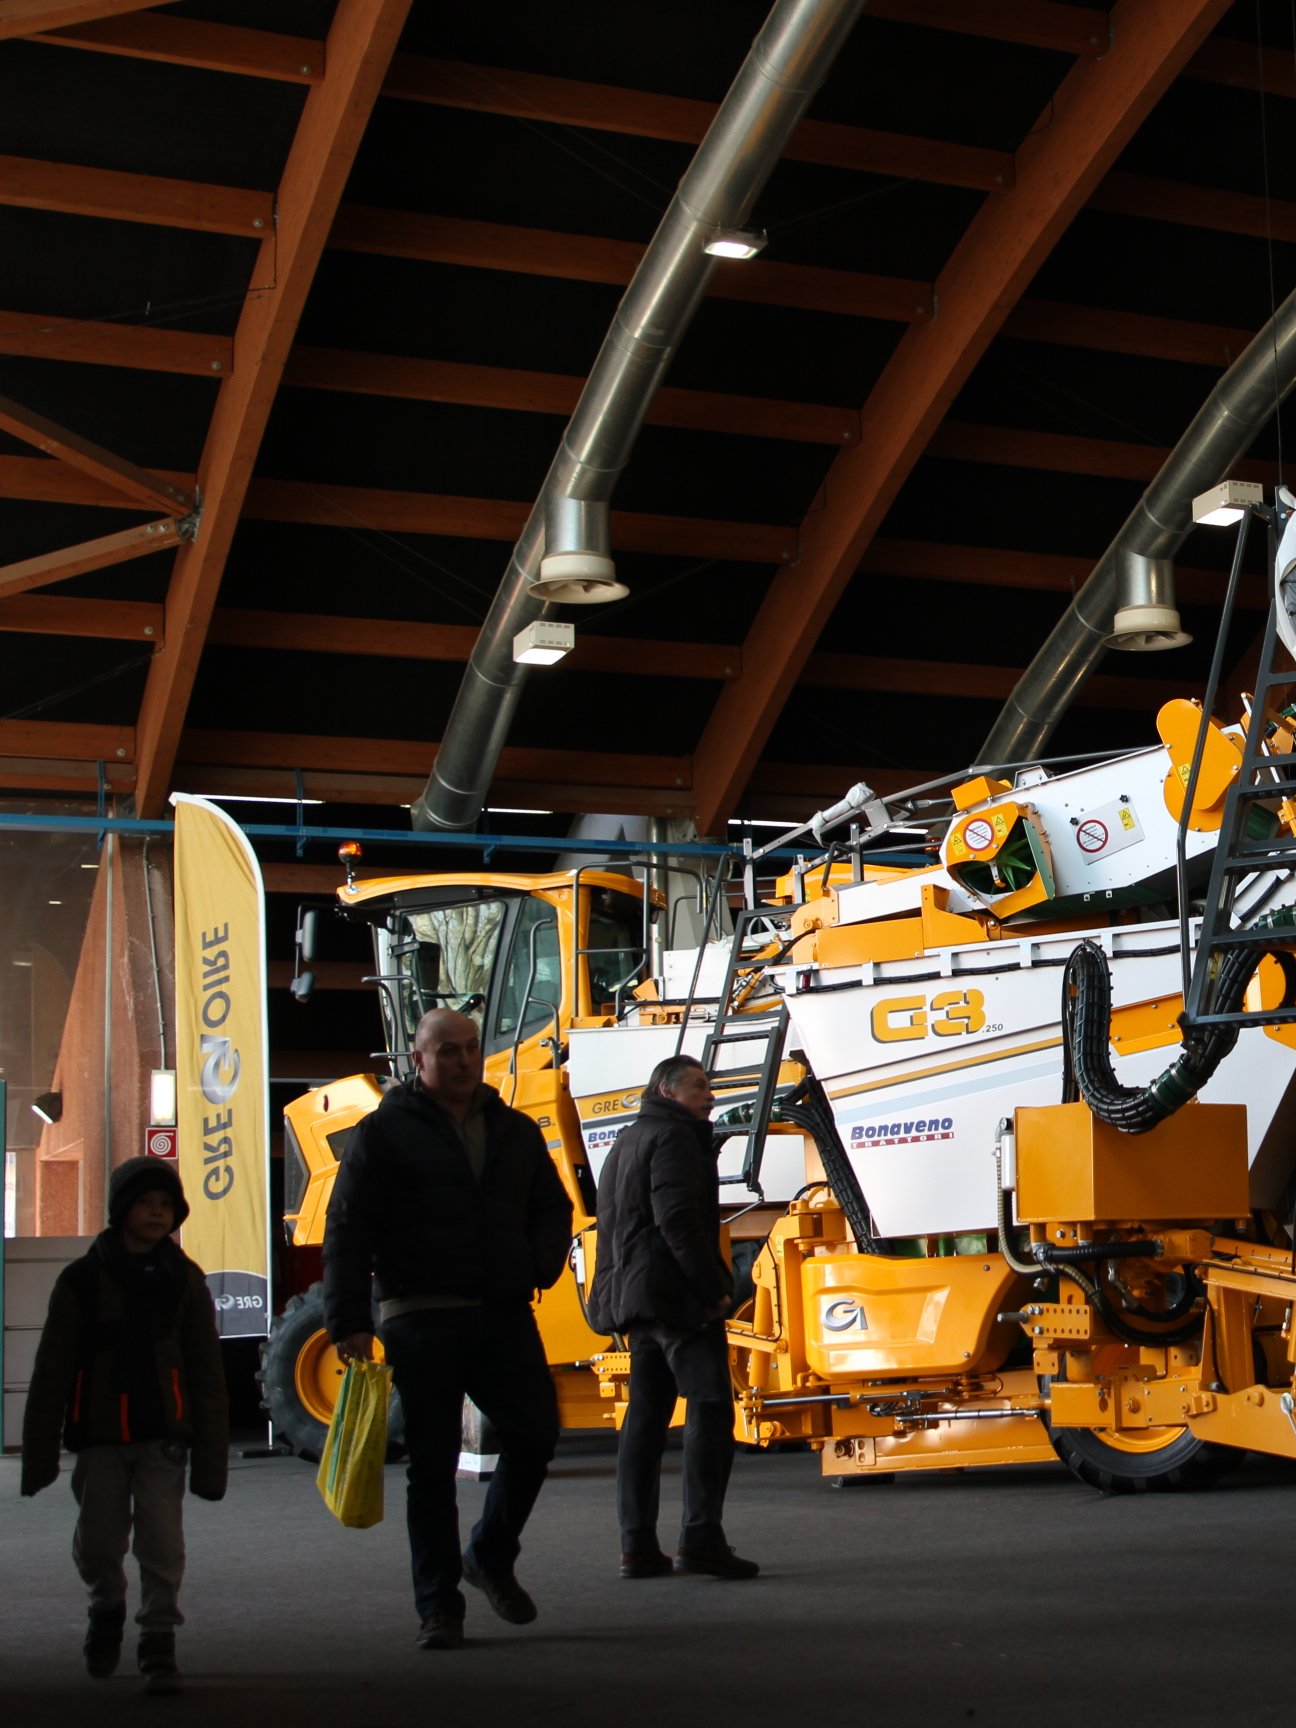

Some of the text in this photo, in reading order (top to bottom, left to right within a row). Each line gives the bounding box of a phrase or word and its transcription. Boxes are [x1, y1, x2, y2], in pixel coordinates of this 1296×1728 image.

[870, 989, 986, 1043] G3
[588, 1129, 619, 1142] Bon
[851, 1118, 953, 1140] Bonaveno
[852, 1132, 953, 1149] TRATTORI
